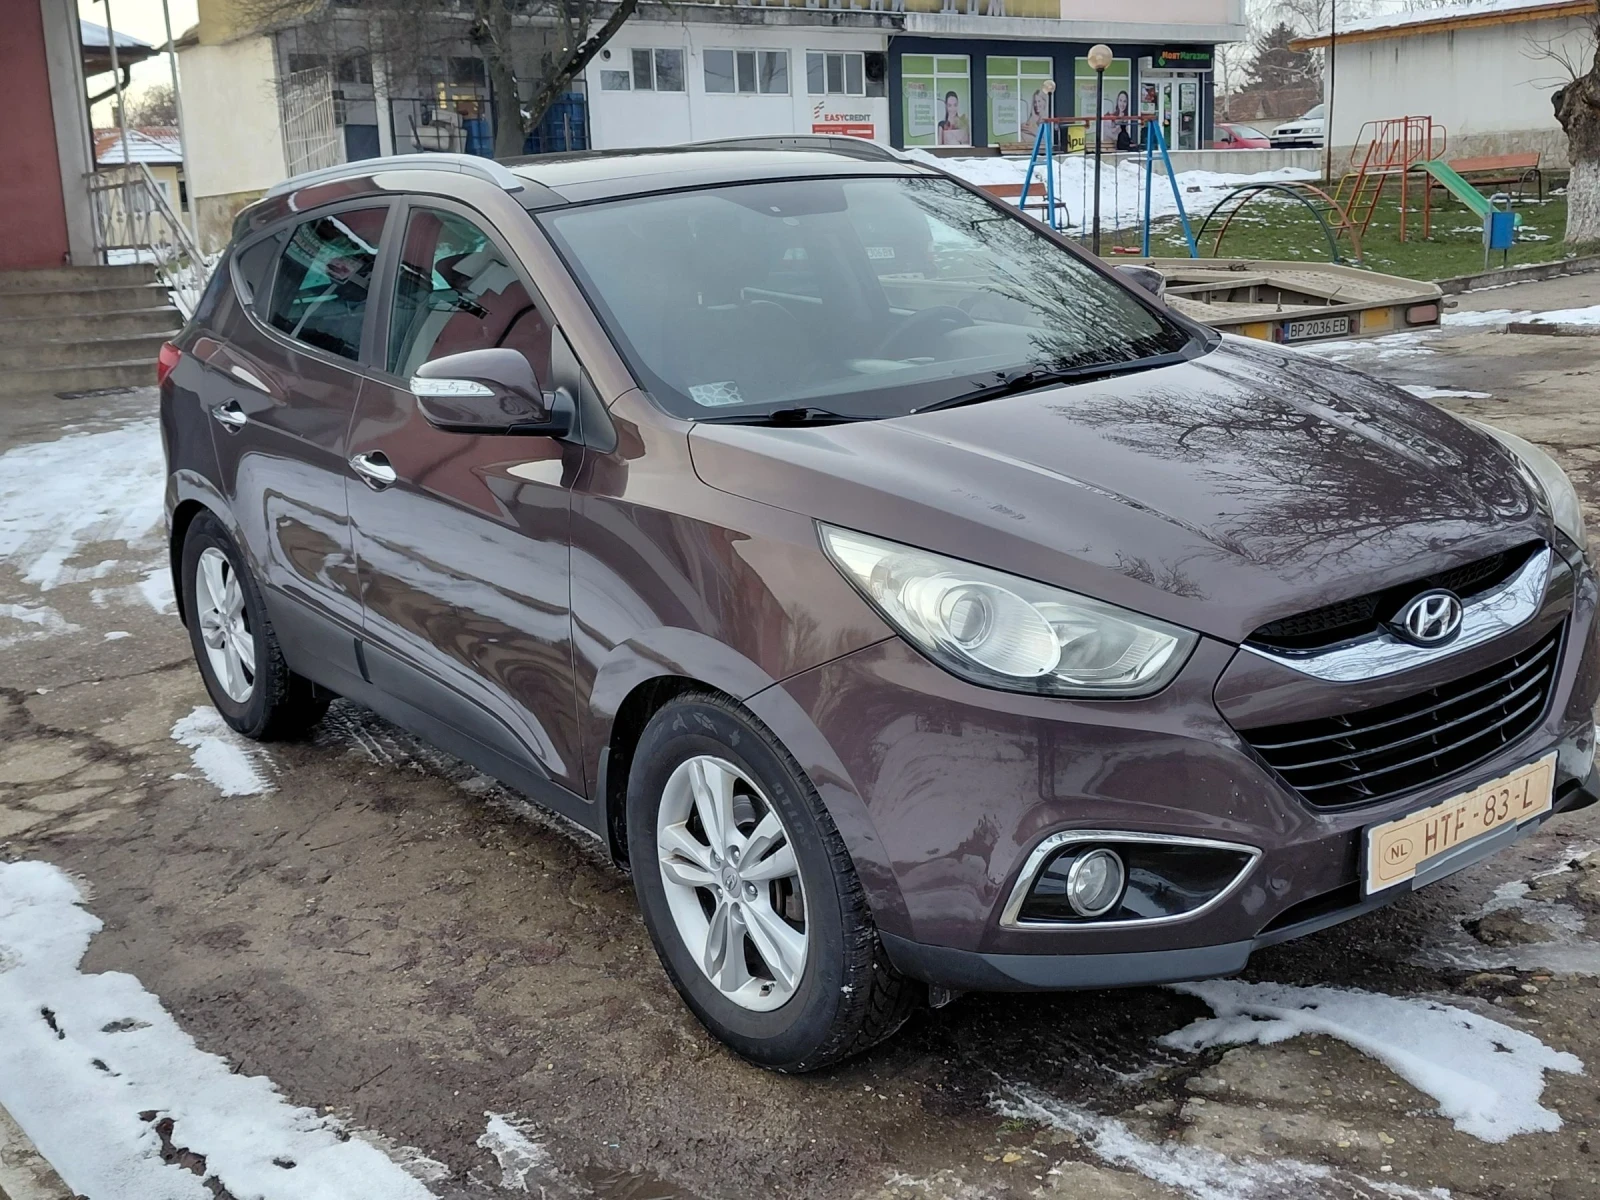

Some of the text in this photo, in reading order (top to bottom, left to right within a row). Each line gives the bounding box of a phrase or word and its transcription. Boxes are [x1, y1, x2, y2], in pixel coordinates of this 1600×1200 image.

[824, 113, 871, 121] EASYCREDIT
[1291, 318, 1346, 337] BP 2036 EB
[1391, 843, 1408, 860] NL
